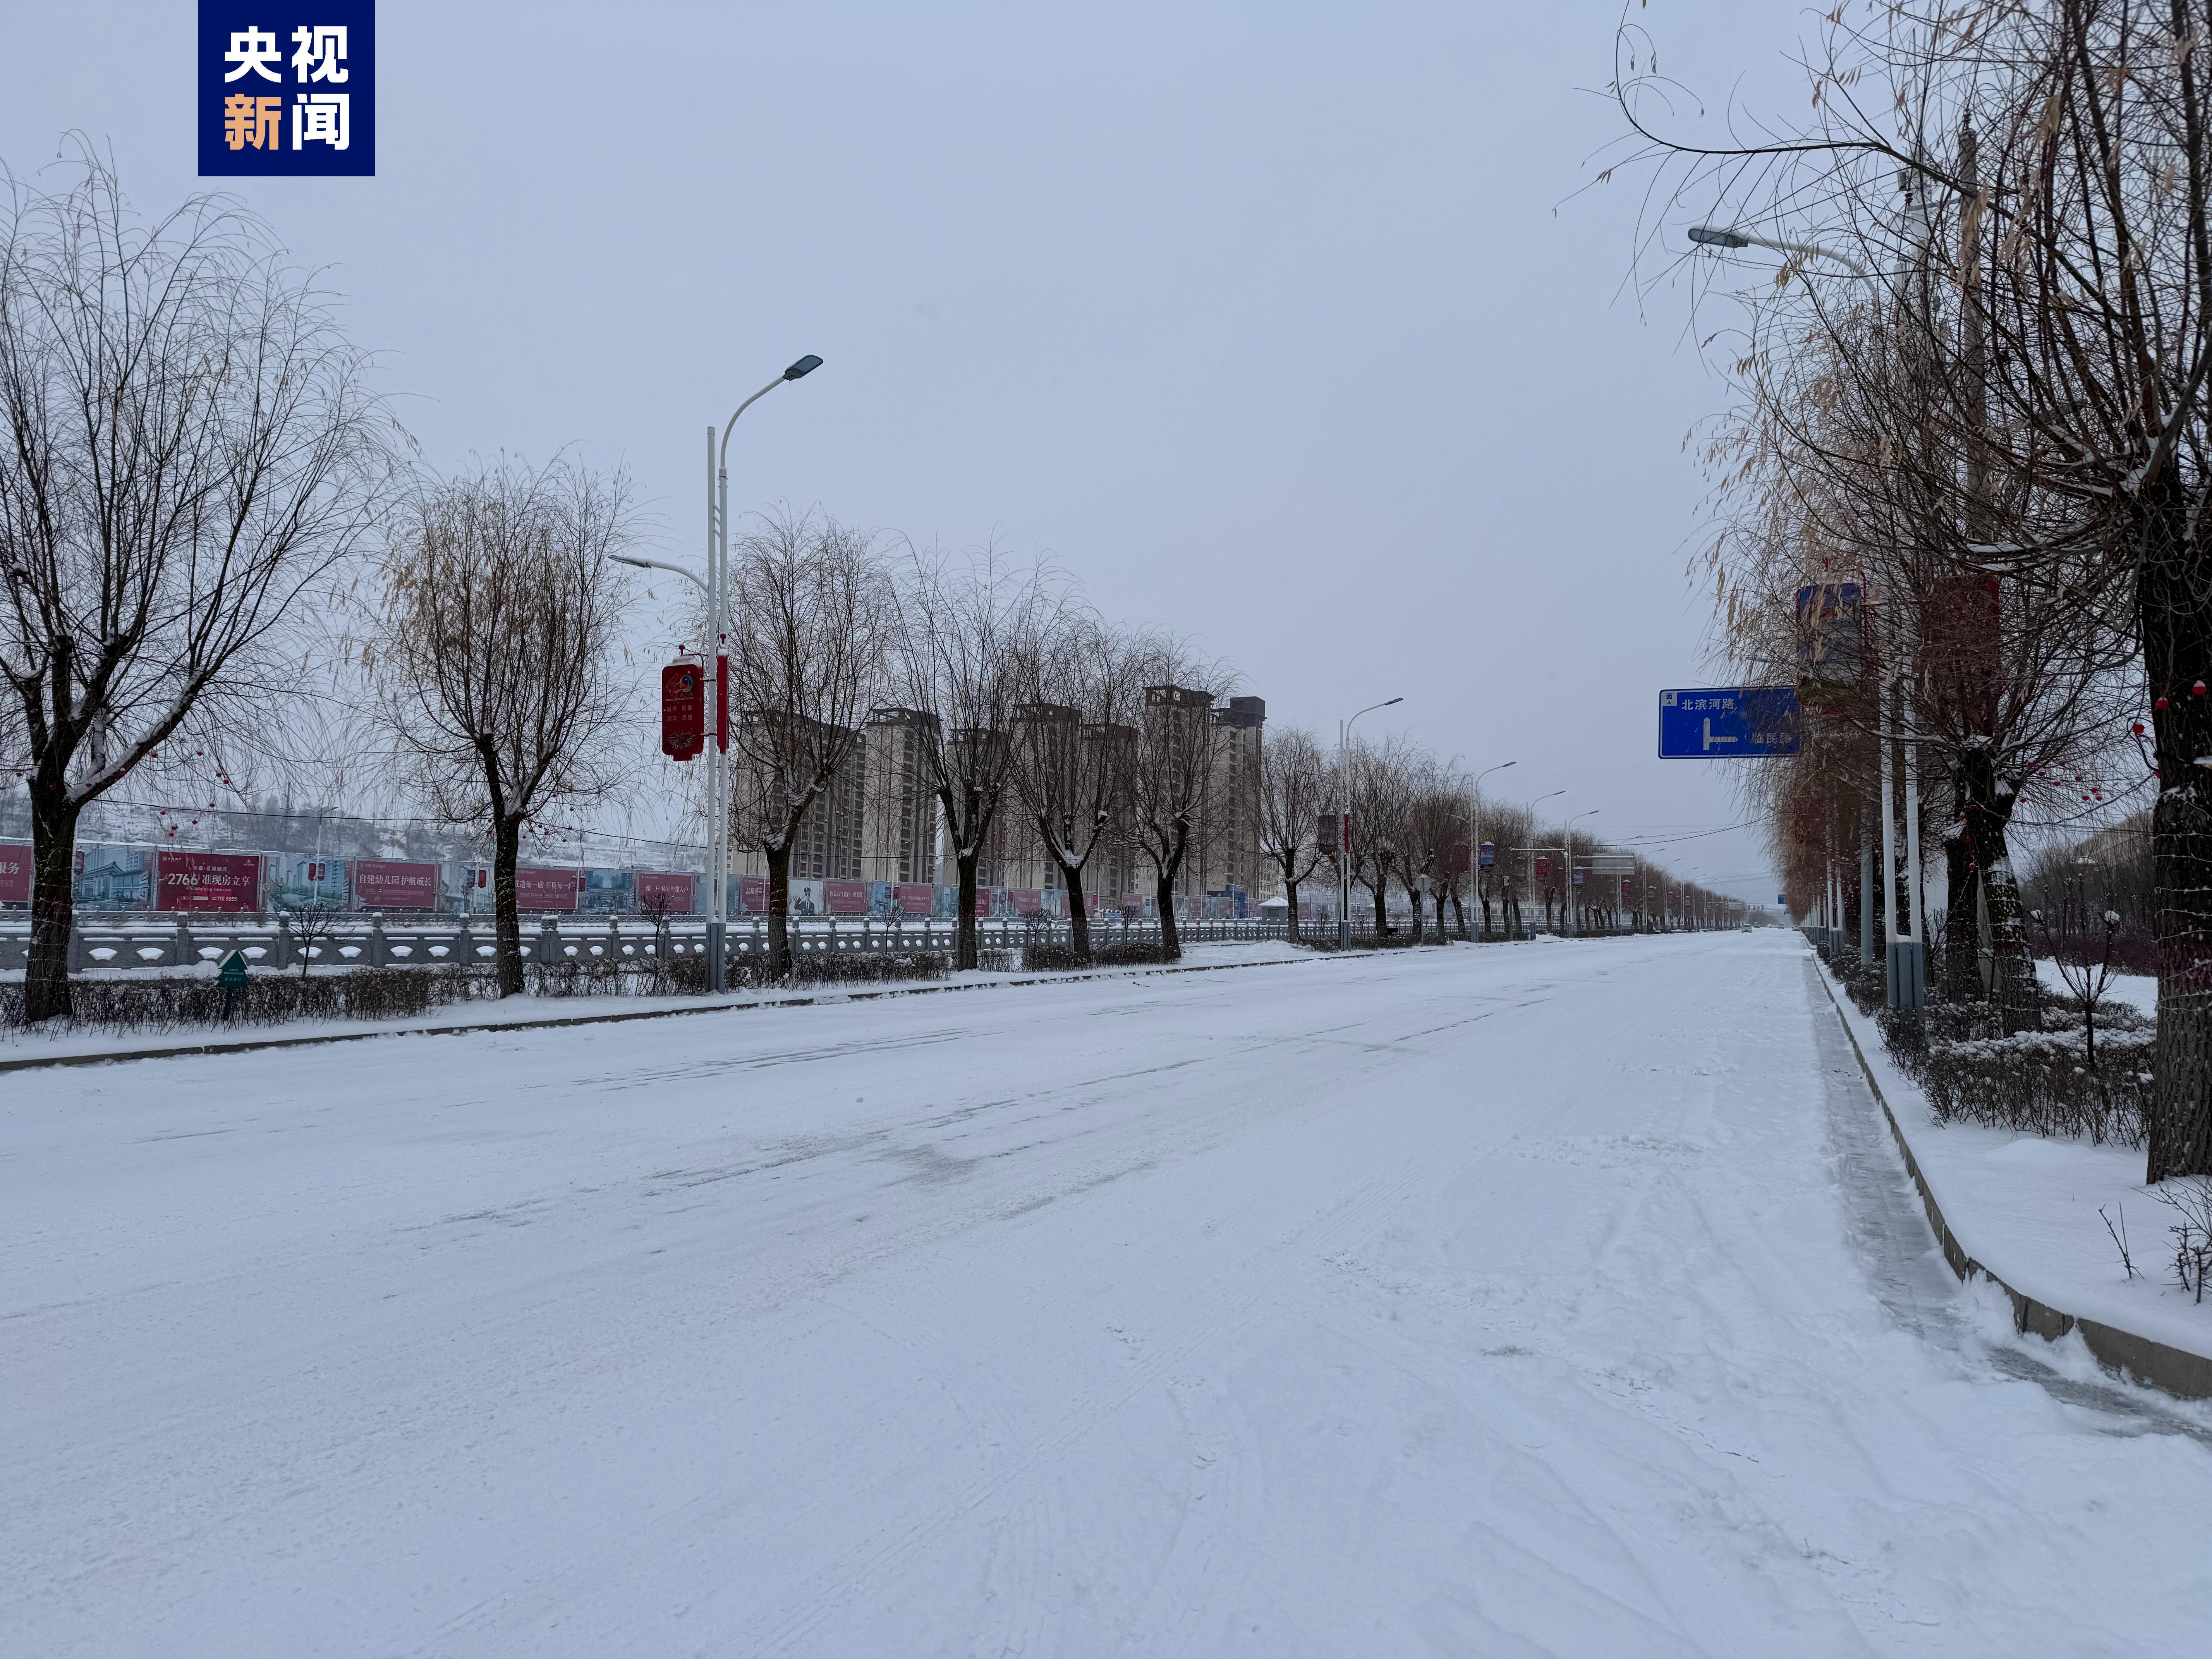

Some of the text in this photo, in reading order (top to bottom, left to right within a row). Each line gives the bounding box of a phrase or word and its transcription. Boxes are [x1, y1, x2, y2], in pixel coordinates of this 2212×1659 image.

[1682, 698, 1734, 710] 北滨河路
[168, 873, 198, 886] 2766
[202, 874, 250, 886] 准现房立享
[359, 874, 431, 886] 自建幼儿园 护航成长
